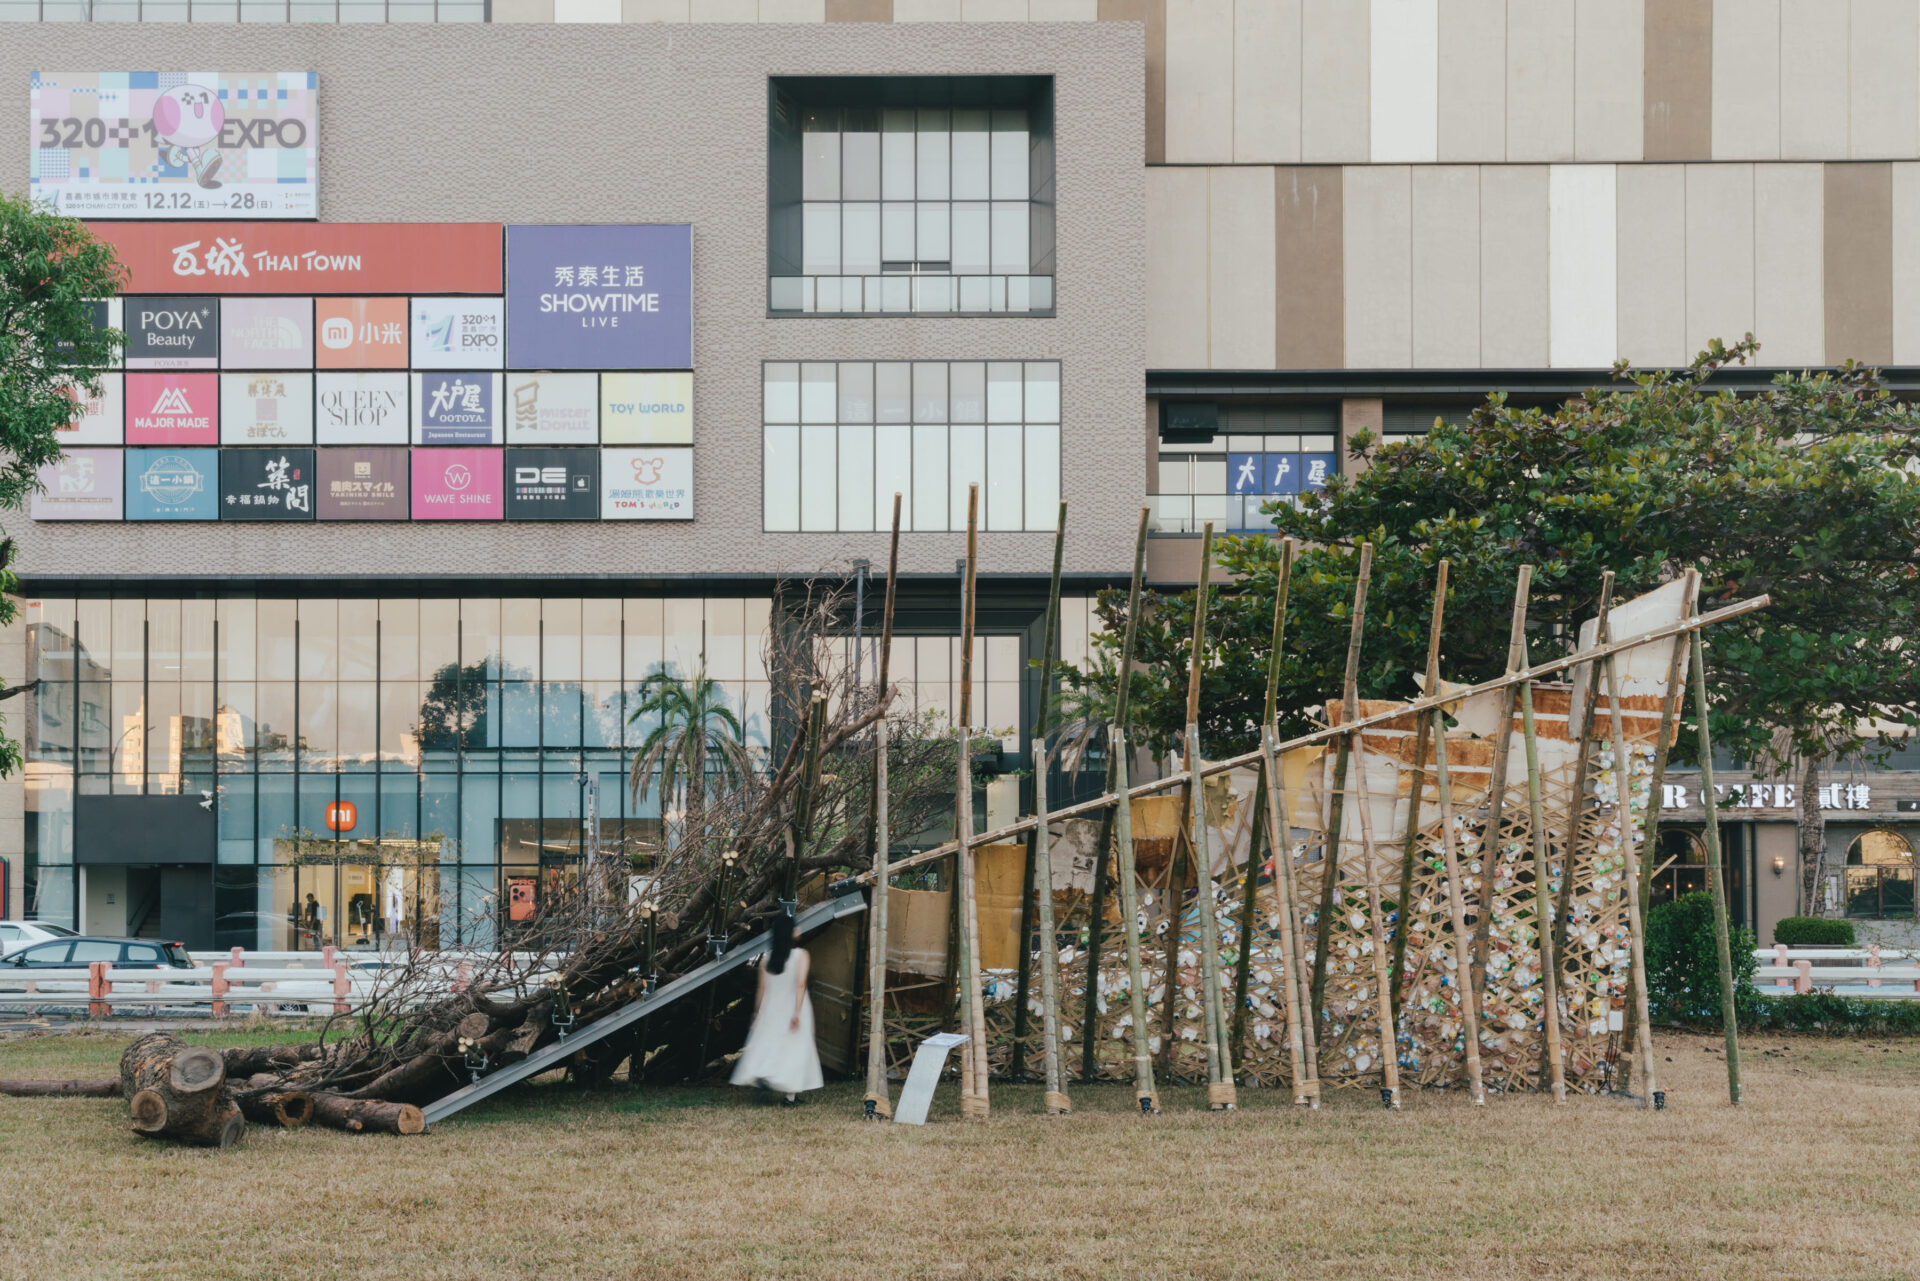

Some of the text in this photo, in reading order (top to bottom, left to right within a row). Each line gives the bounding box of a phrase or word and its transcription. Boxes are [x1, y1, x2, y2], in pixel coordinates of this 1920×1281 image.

[218, 119, 306, 148] EXPO
[172, 237, 249, 277] 瓦城
[253, 250, 361, 271] THAI TOWN
[554, 265, 644, 287] 秀泰生活
[540, 294, 659, 312] SHOWTIME
[141, 311, 203, 330] POYA
[582, 317, 619, 328] LIVE
[147, 333, 196, 350] Beauty
[232, 328, 278, 338] NORTH
[358, 322, 402, 344] 小米
[462, 334, 498, 347] EXPO
[243, 338, 278, 349] FACE
[321, 390, 396, 409] QUEEN
[609, 402, 685, 414] TOY WORLD
[135, 417, 209, 428] MAJOR MADE
[330, 408, 387, 426] SHOP
[439, 414, 482, 423] OOTOYA
[516, 467, 567, 484] DE
[225, 494, 280, 505] 幸福鍋物
[424, 494, 492, 504] WAVE SHINE
